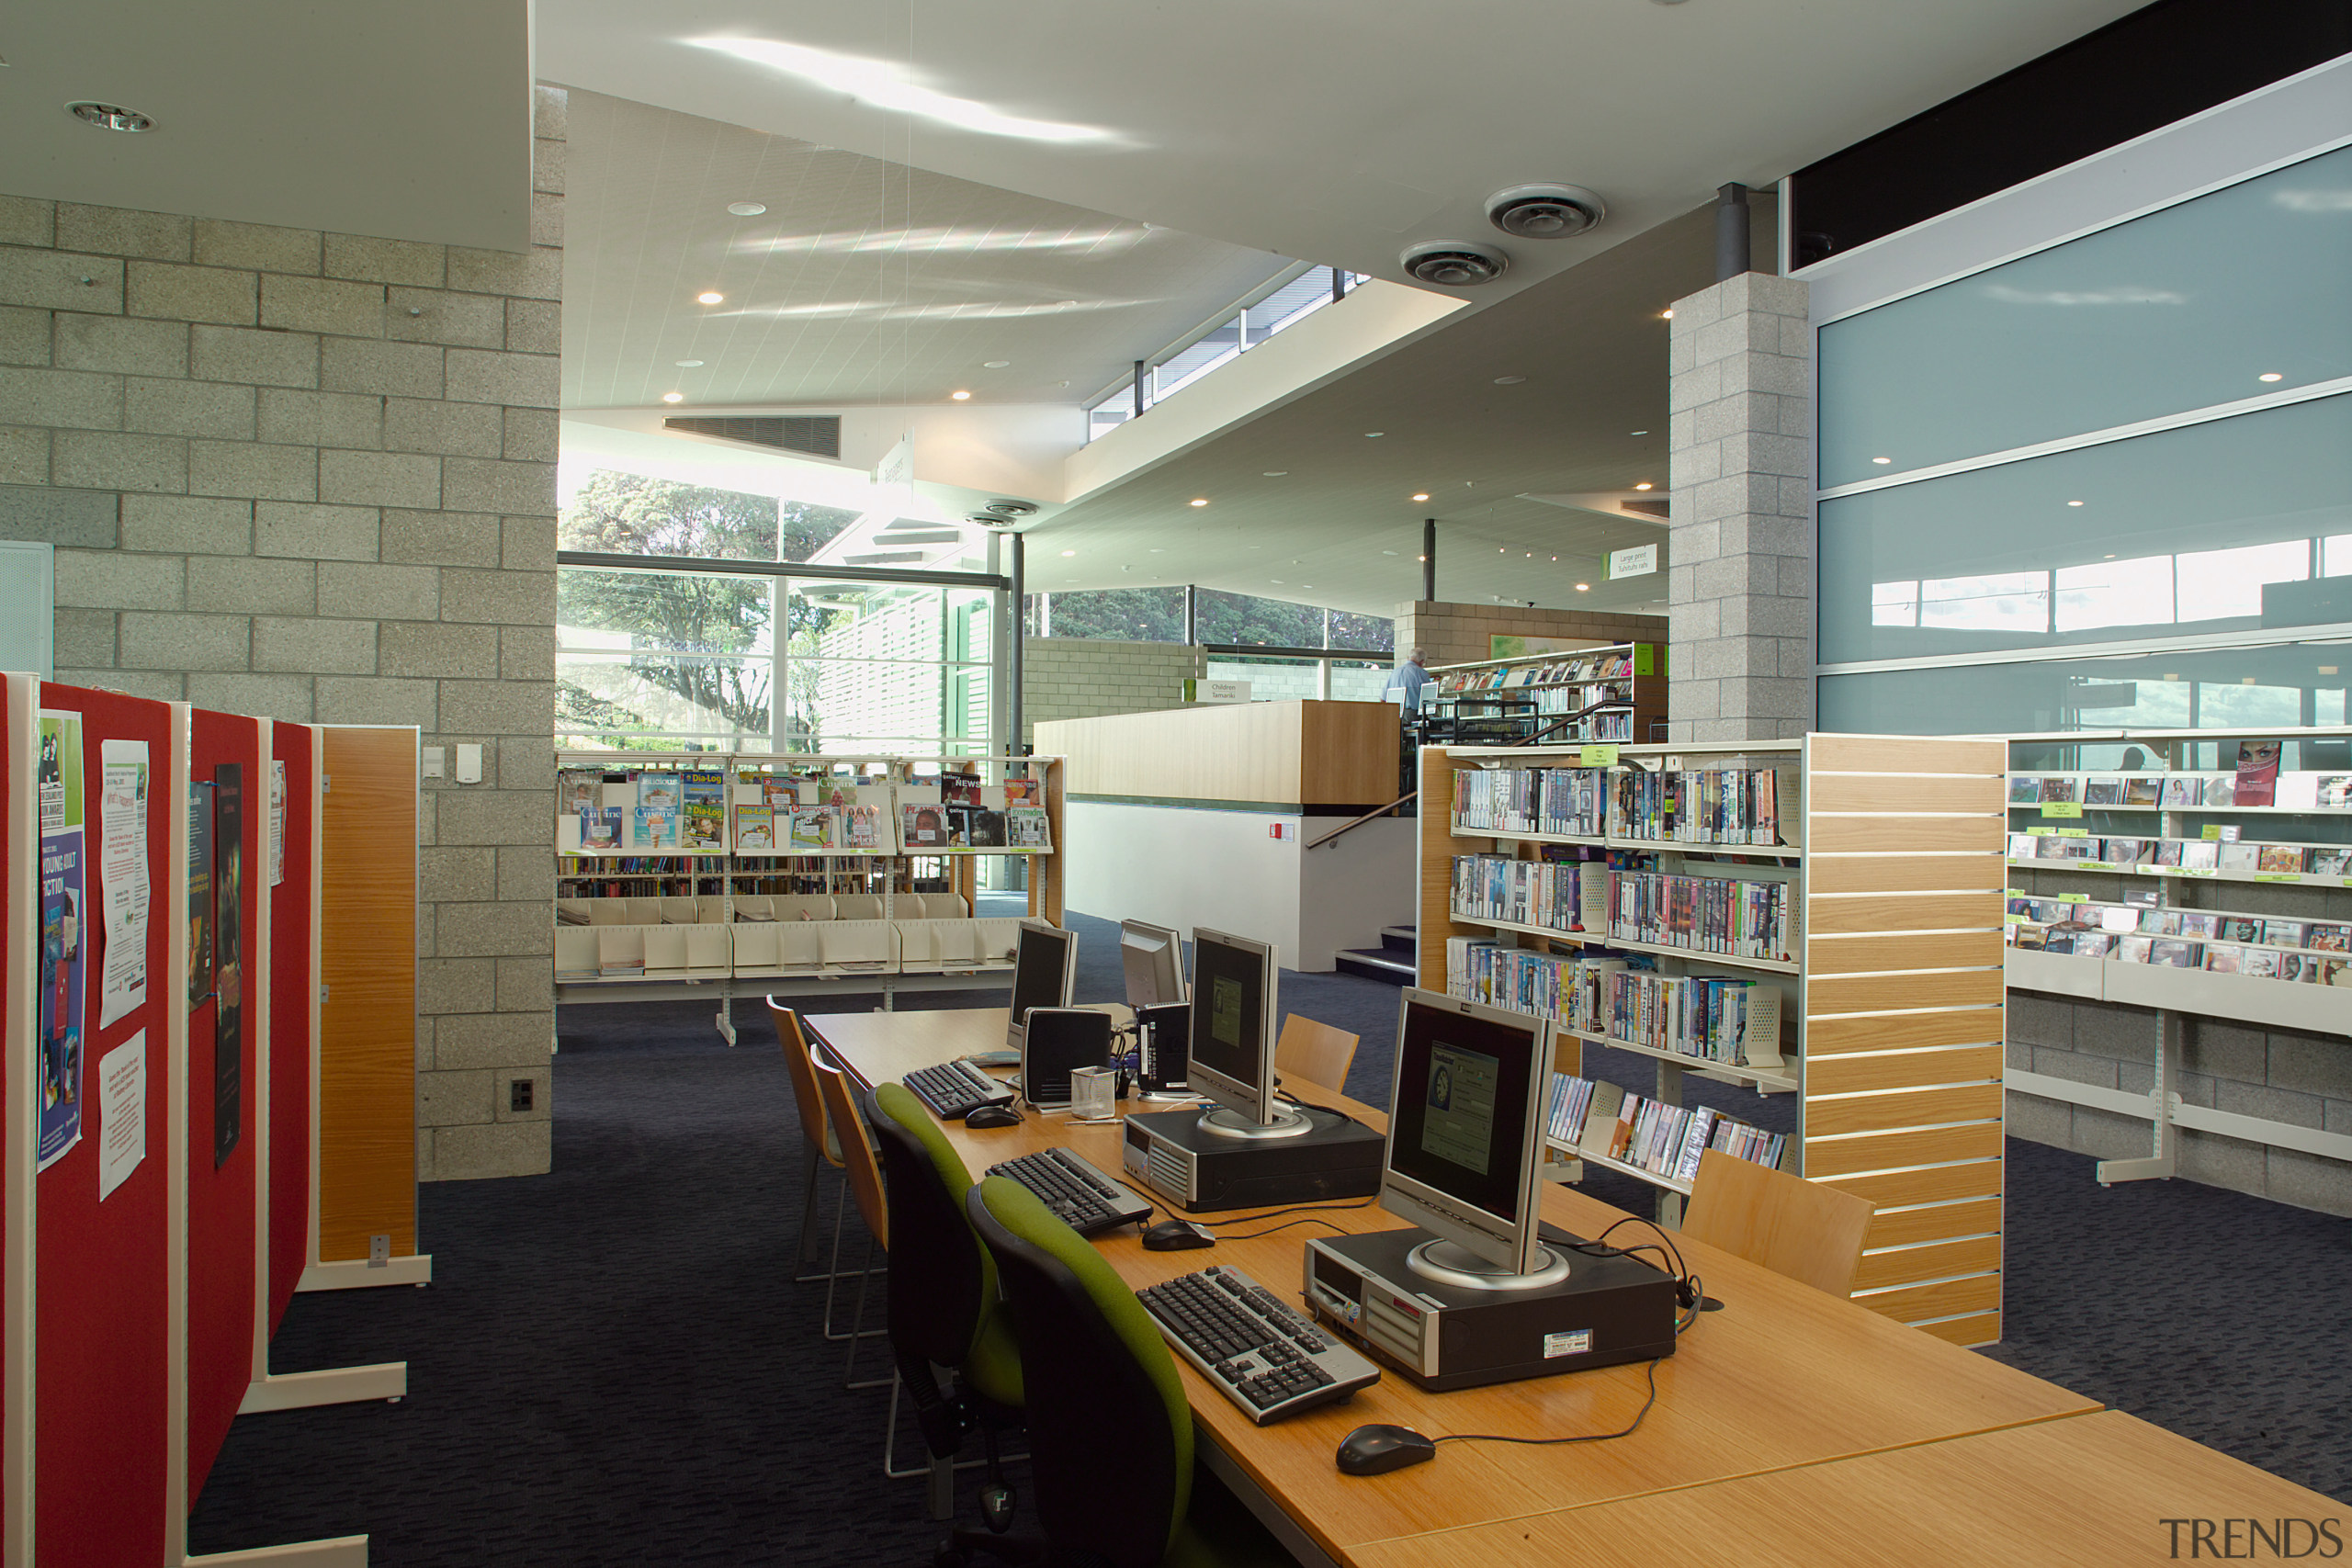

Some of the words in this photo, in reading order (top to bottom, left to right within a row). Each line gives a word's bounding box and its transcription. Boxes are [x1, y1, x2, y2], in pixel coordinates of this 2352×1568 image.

[562, 775, 602, 785] Cuisine
[693, 774, 722, 784] Dia-Log
[956, 780, 981, 788] NEWS
[693, 807, 722, 818] Dia-Log
[739, 807, 771, 816] Dia-Log
[43, 855, 63, 875] YOUNG
